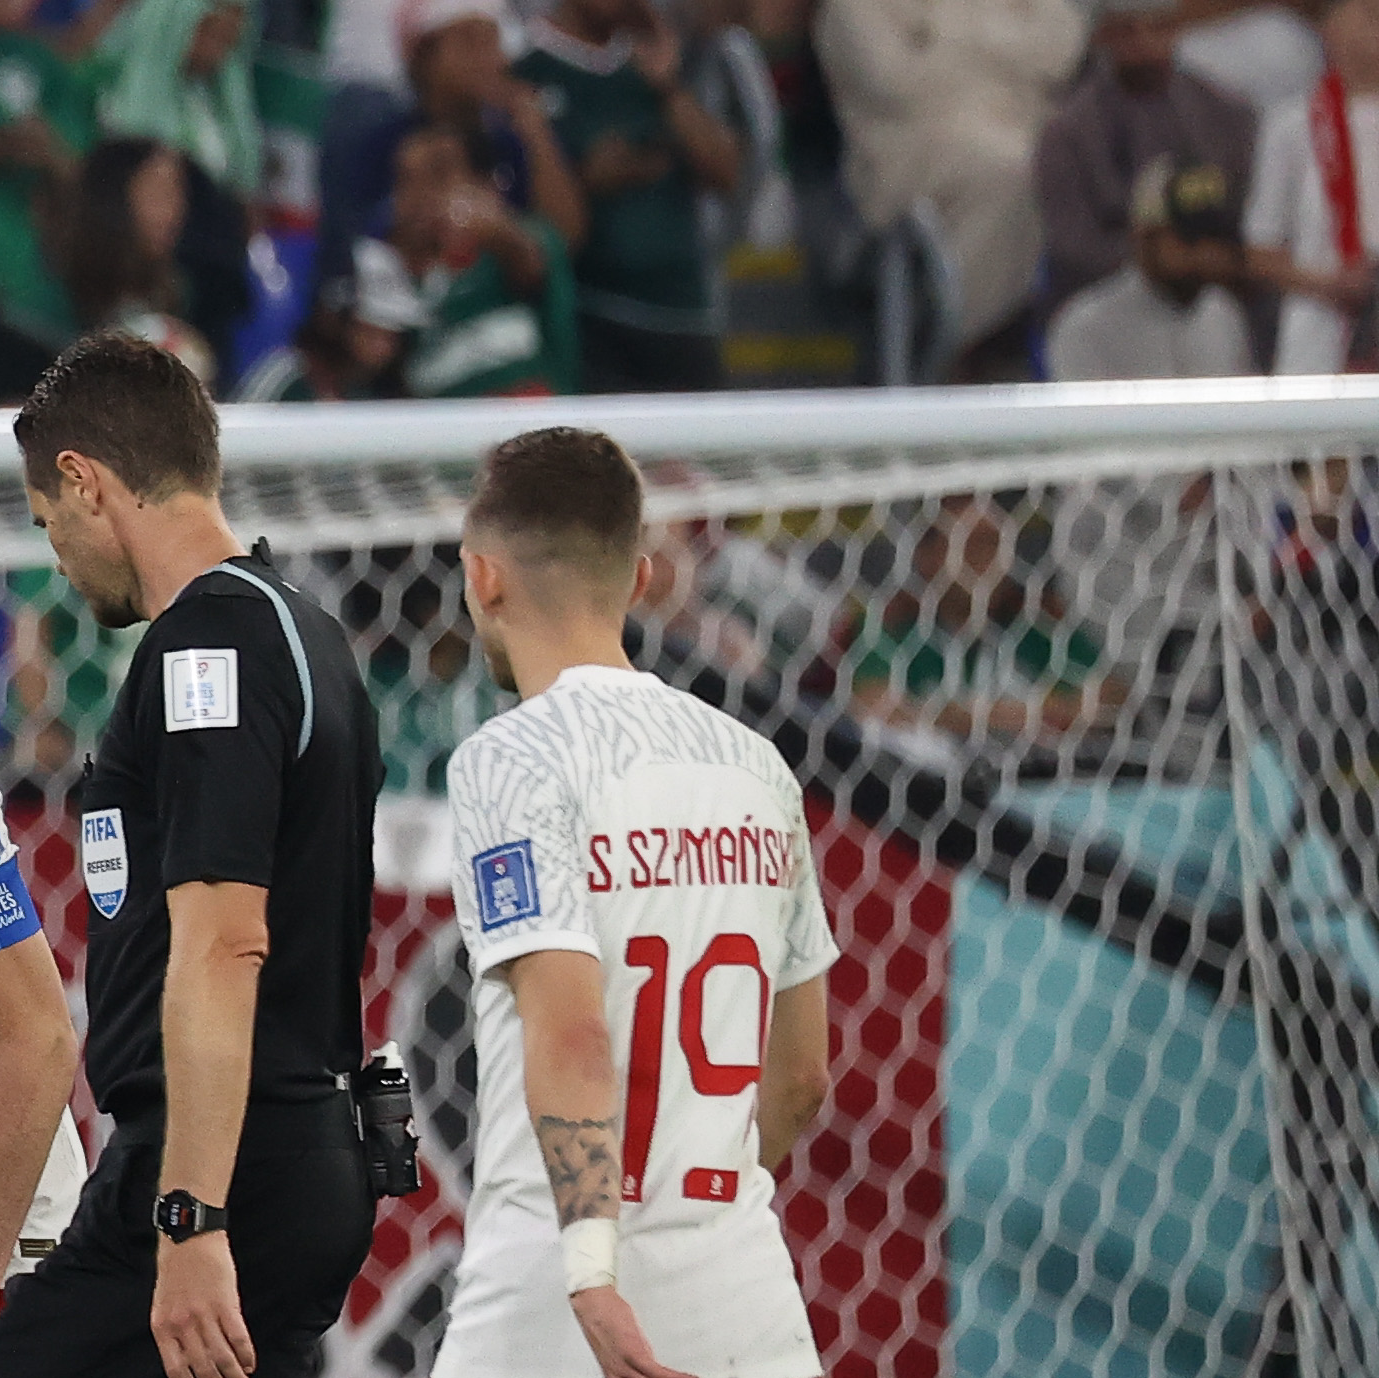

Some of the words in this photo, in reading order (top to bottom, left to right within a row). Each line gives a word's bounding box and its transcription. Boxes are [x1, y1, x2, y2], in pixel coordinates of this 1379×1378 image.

[85, 816, 118, 843] FIFA
[87, 857, 123, 874] REFEREE
[588, 834, 622, 893] S.
[622, 933, 769, 1202] 19
